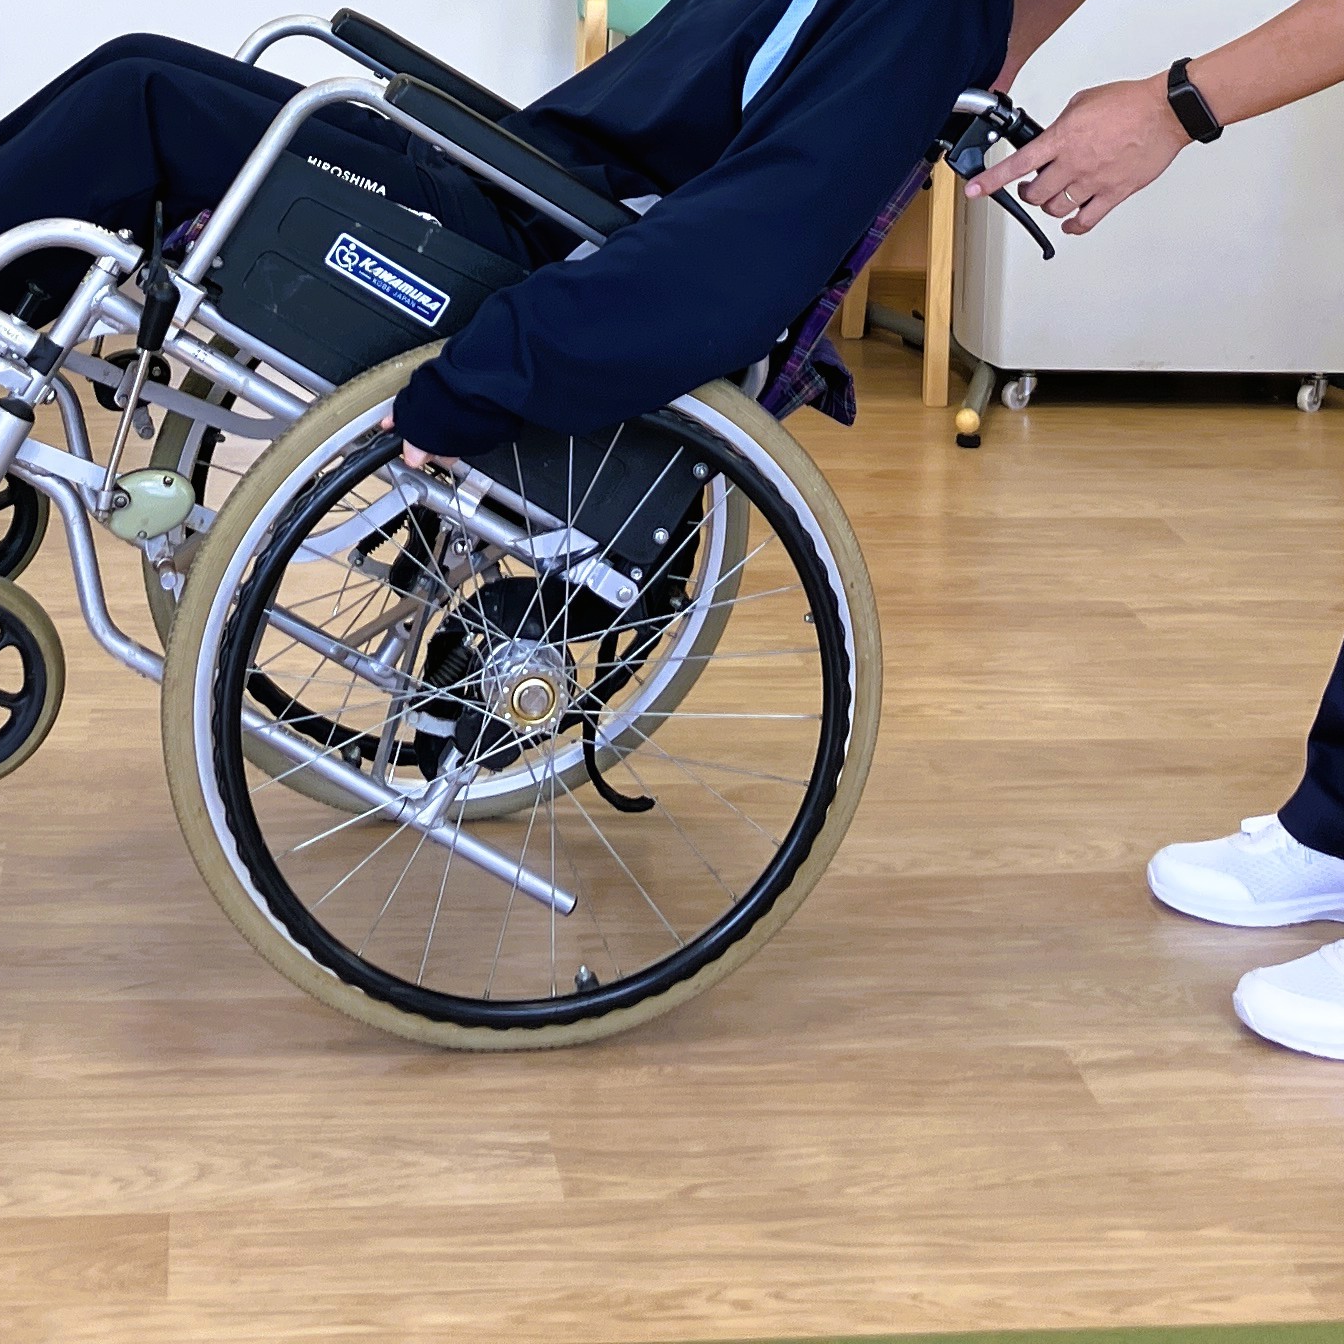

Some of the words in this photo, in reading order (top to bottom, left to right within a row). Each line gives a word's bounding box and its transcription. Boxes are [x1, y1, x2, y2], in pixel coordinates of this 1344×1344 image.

[358, 256, 442, 312] KAWAMURA
[372, 278, 392, 293] KOBE
[392, 290, 416, 308] JAPAN
